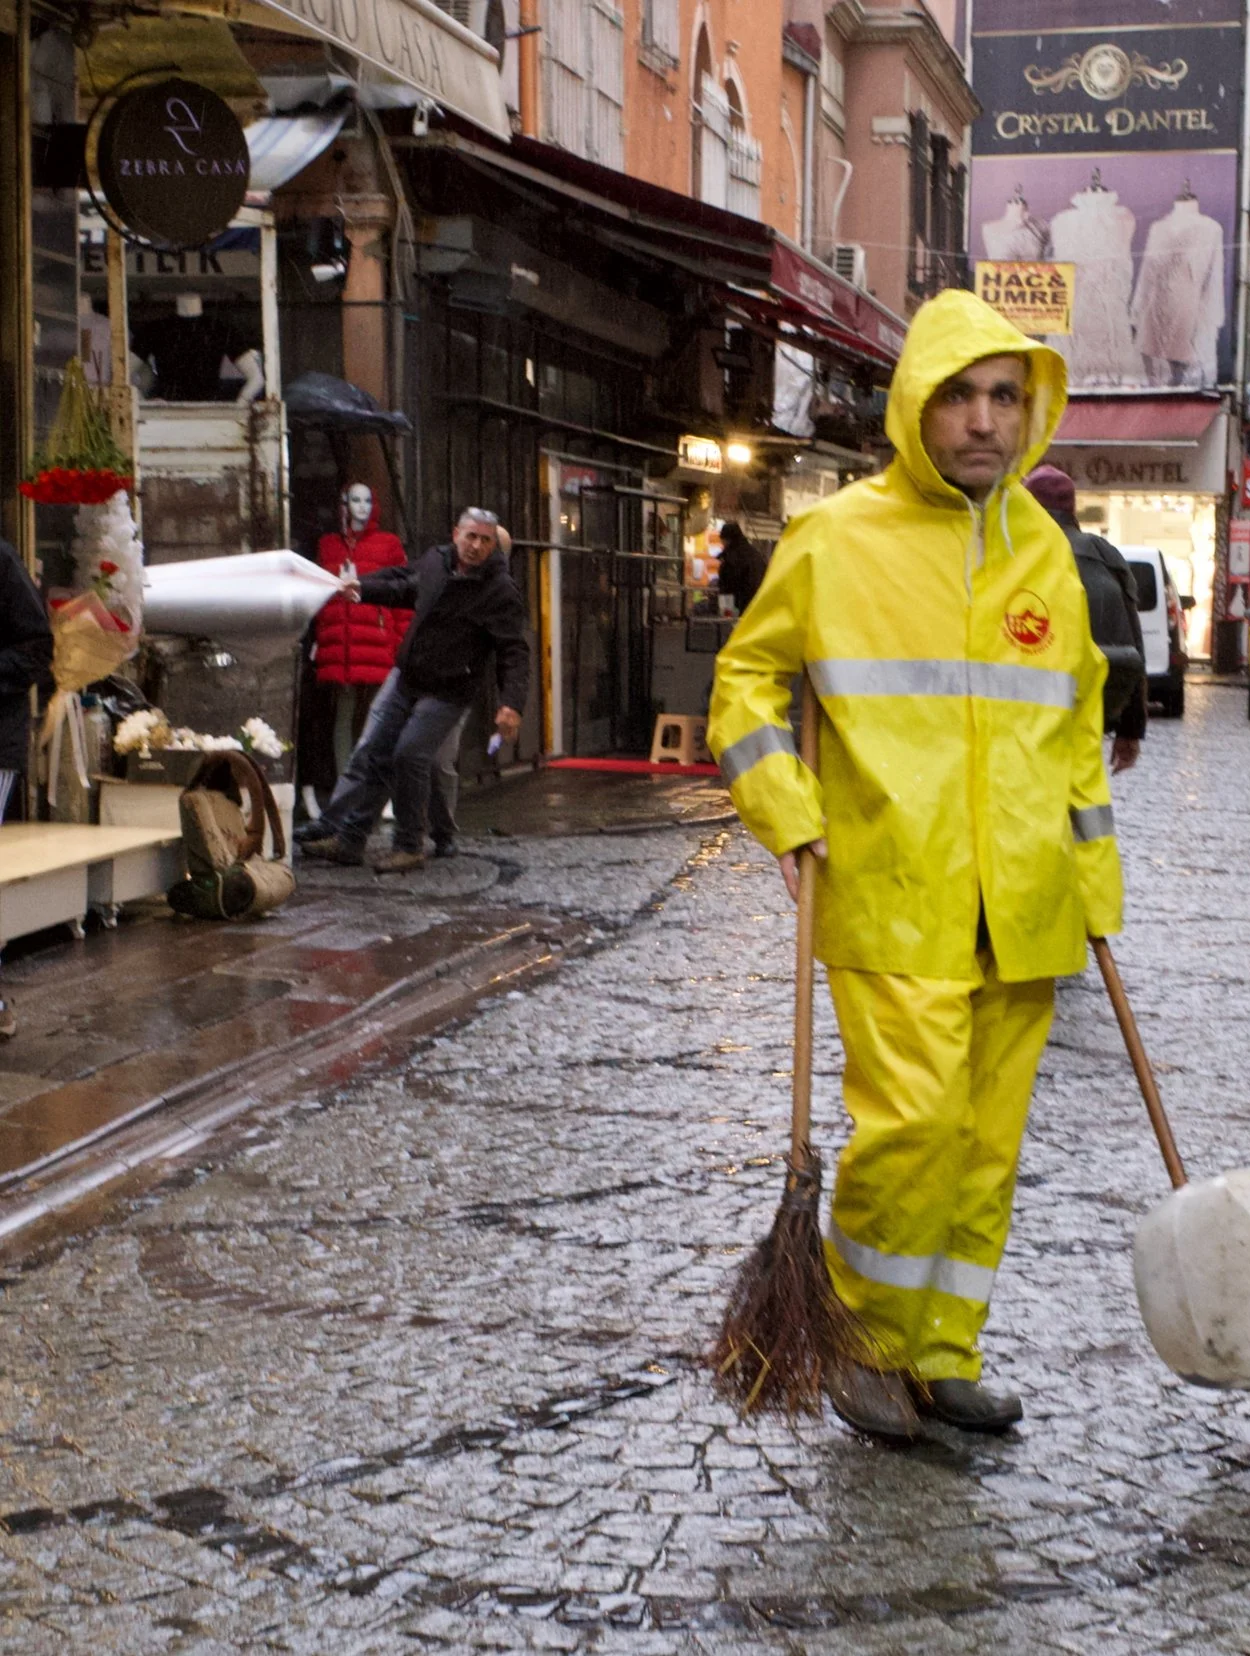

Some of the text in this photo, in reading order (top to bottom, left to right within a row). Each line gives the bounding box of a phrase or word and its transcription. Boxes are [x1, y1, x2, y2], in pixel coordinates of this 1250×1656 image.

[996, 107, 1215, 140] CRYSTAL DANTEL
[119, 159, 246, 176] ZEBRA CASA
[982, 290, 1067, 305] UMRE
[1086, 456, 1189, 485] DANTEL
